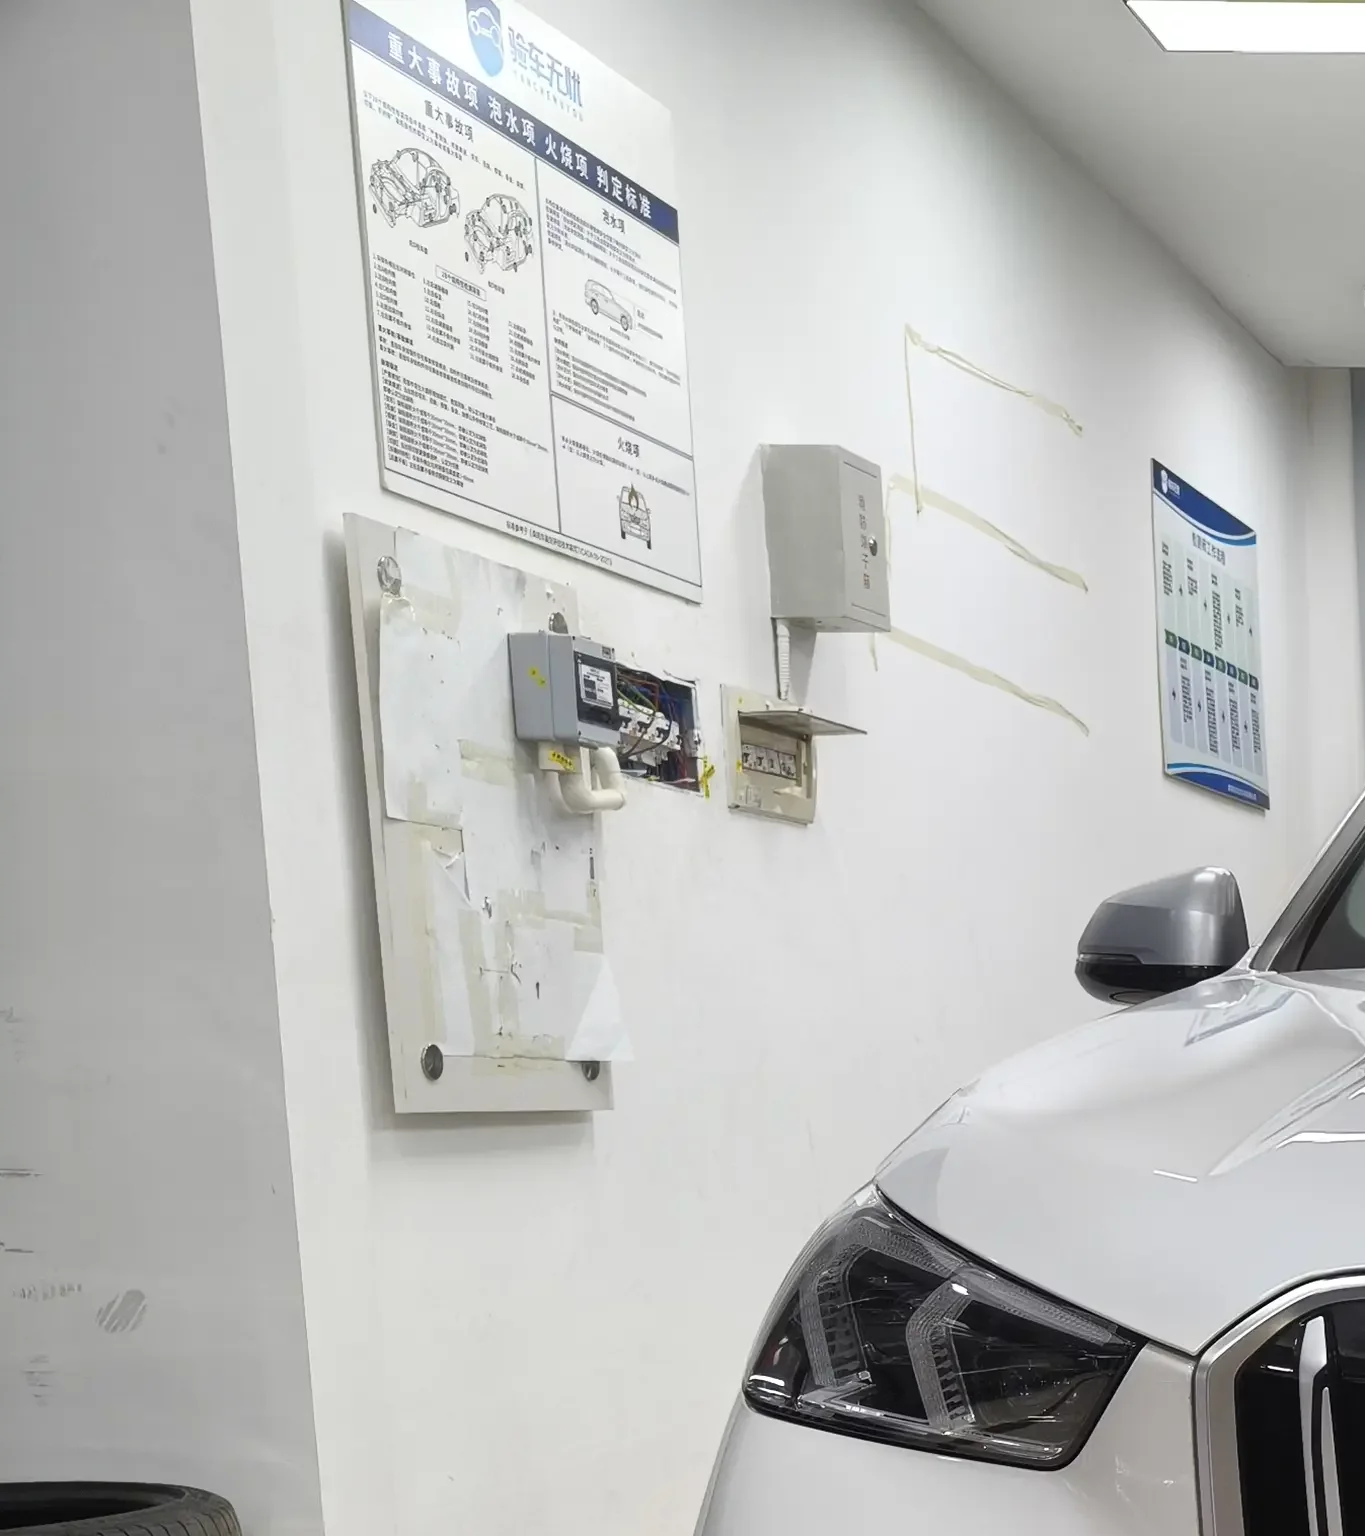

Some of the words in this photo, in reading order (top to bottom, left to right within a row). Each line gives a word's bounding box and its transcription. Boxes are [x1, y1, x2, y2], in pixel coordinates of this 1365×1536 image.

[508, 26, 583, 108] 验车无忧
[388, 33, 480, 111] 重大事故项
[487, 95, 537, 147] 泡水项
[544, 132, 589, 181] 火烧项
[595, 165, 652, 220] 判定标准
[424, 100, 474, 143] 重大事故项
